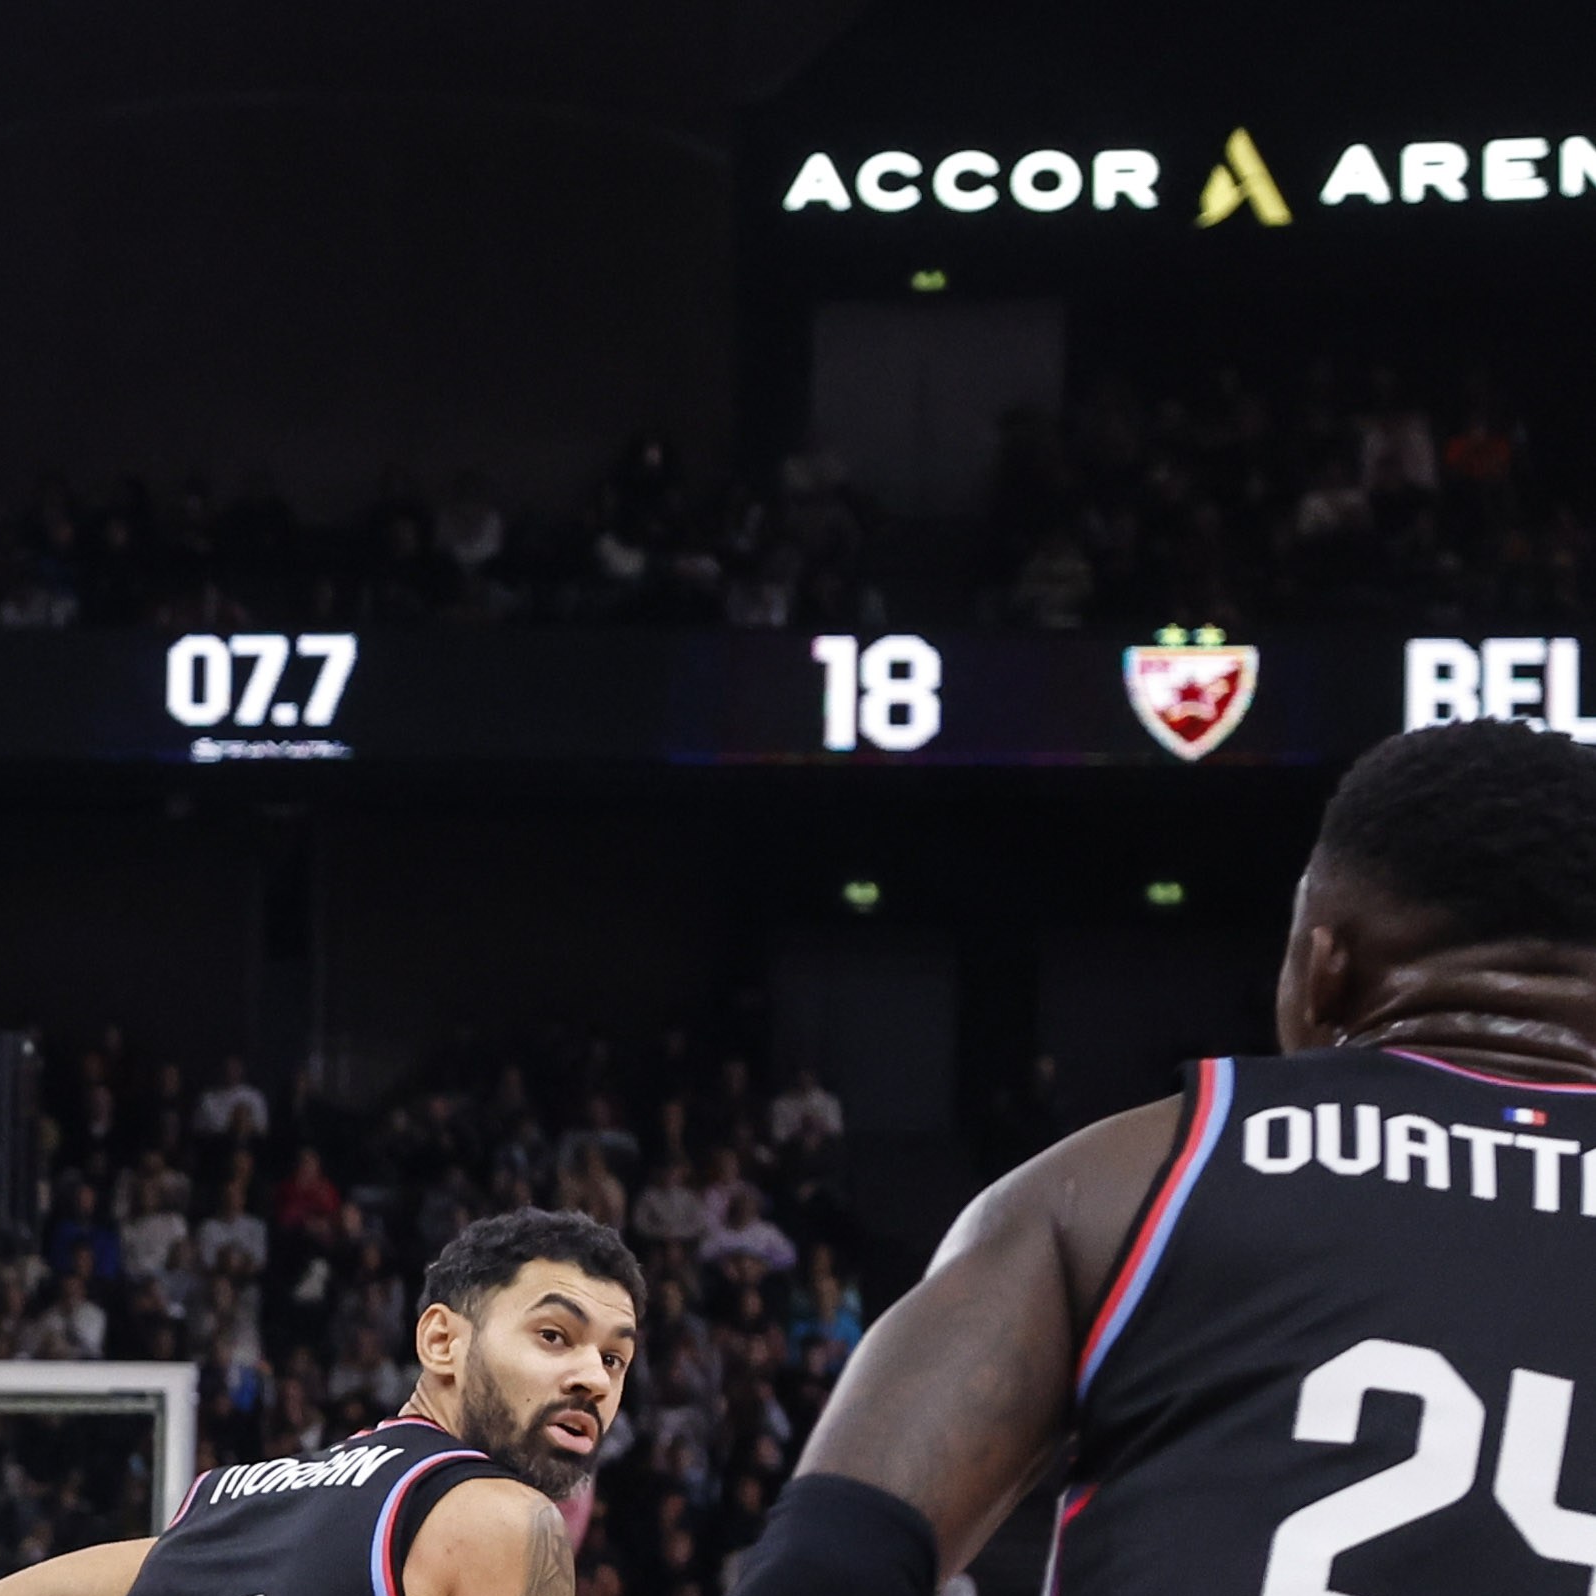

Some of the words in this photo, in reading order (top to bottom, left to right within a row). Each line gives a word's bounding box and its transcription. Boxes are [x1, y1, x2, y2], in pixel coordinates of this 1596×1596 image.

[783, 149, 1161, 213] ACCOR
[166, 633, 358, 727] 07.7
[813, 634, 942, 751] 18
[1404, 637, 1596, 744] BEL
[1243, 1103, 1596, 1216] OUATT
